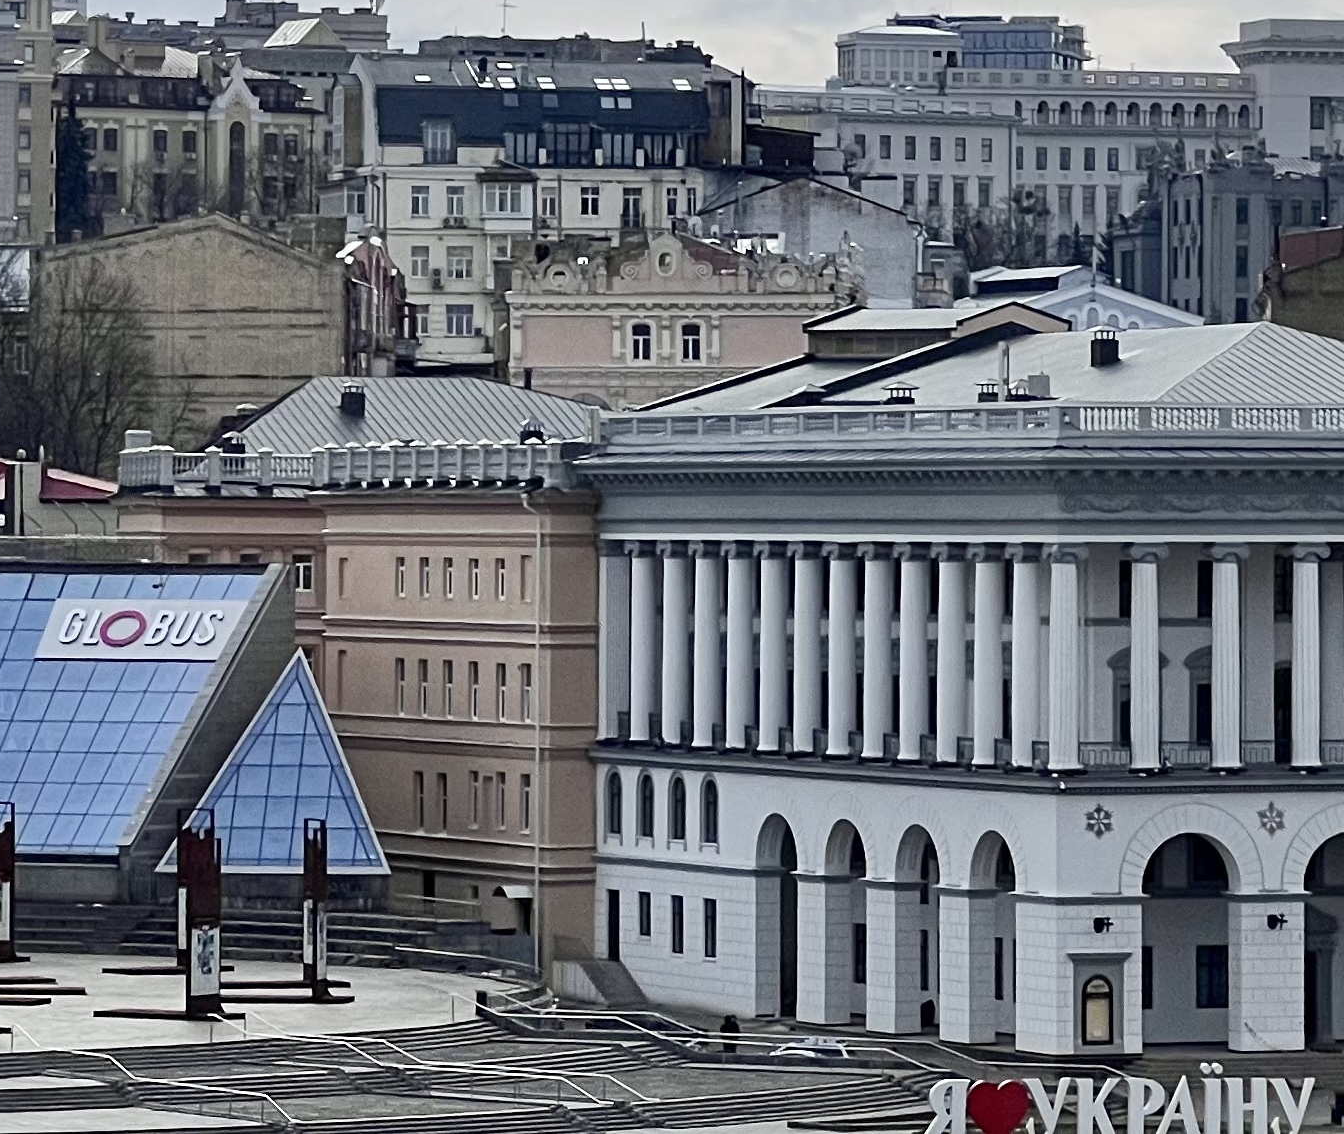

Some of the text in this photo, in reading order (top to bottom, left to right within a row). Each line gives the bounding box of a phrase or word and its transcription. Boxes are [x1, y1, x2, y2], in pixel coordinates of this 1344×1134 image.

[58, 608, 224, 648] GLOBUS
[923, 1061, 1316, 1134] Я УКРАЇНУ
